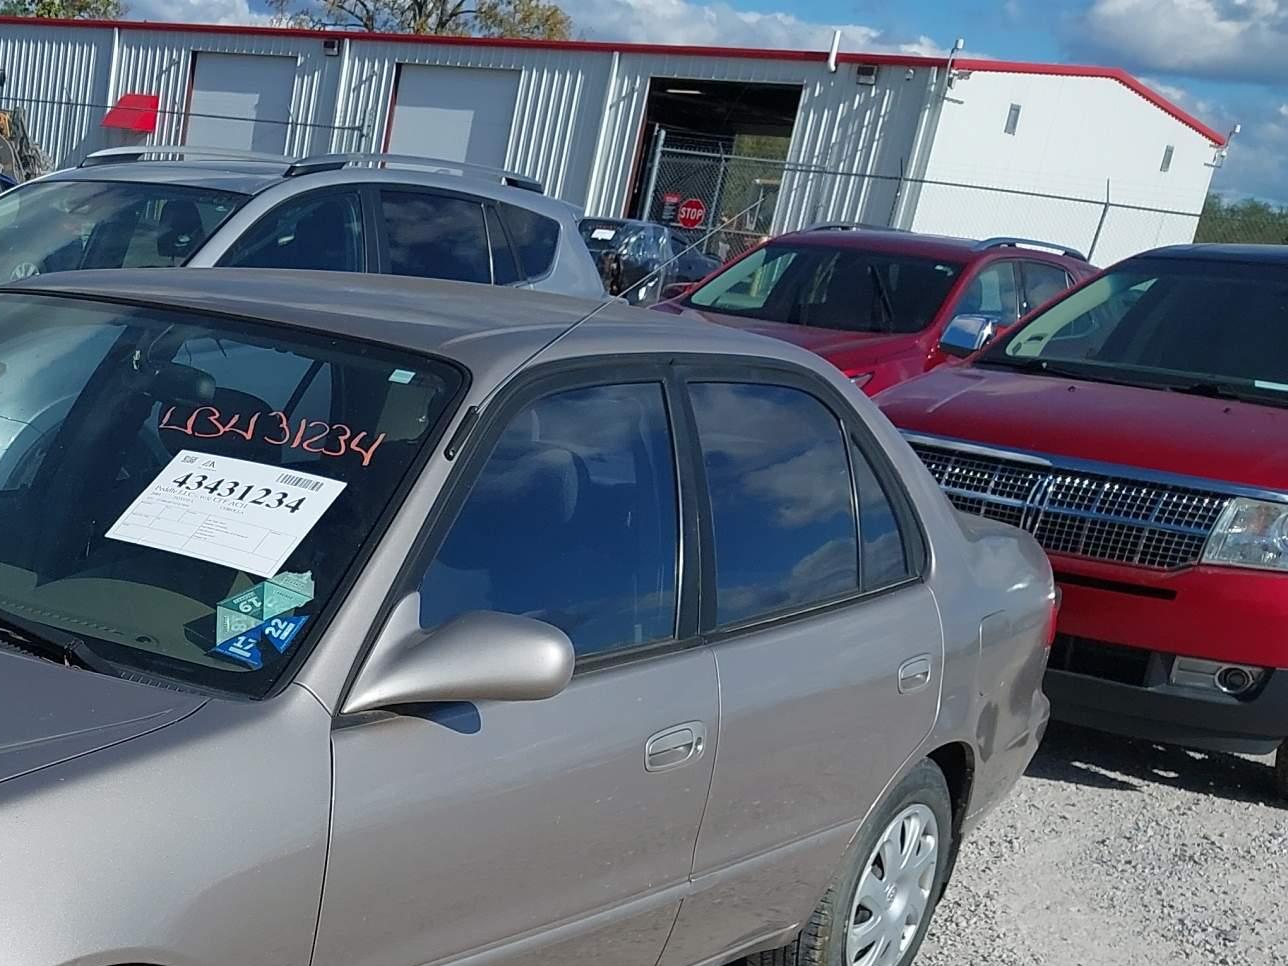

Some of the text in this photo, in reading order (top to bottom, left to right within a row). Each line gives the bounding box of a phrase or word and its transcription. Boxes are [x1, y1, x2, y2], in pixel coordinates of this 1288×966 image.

[680, 206, 703, 220] STOP
[172, 471, 306, 513] 43431234
[265, 618, 287, 638] 22
[232, 636, 257, 650] 17
